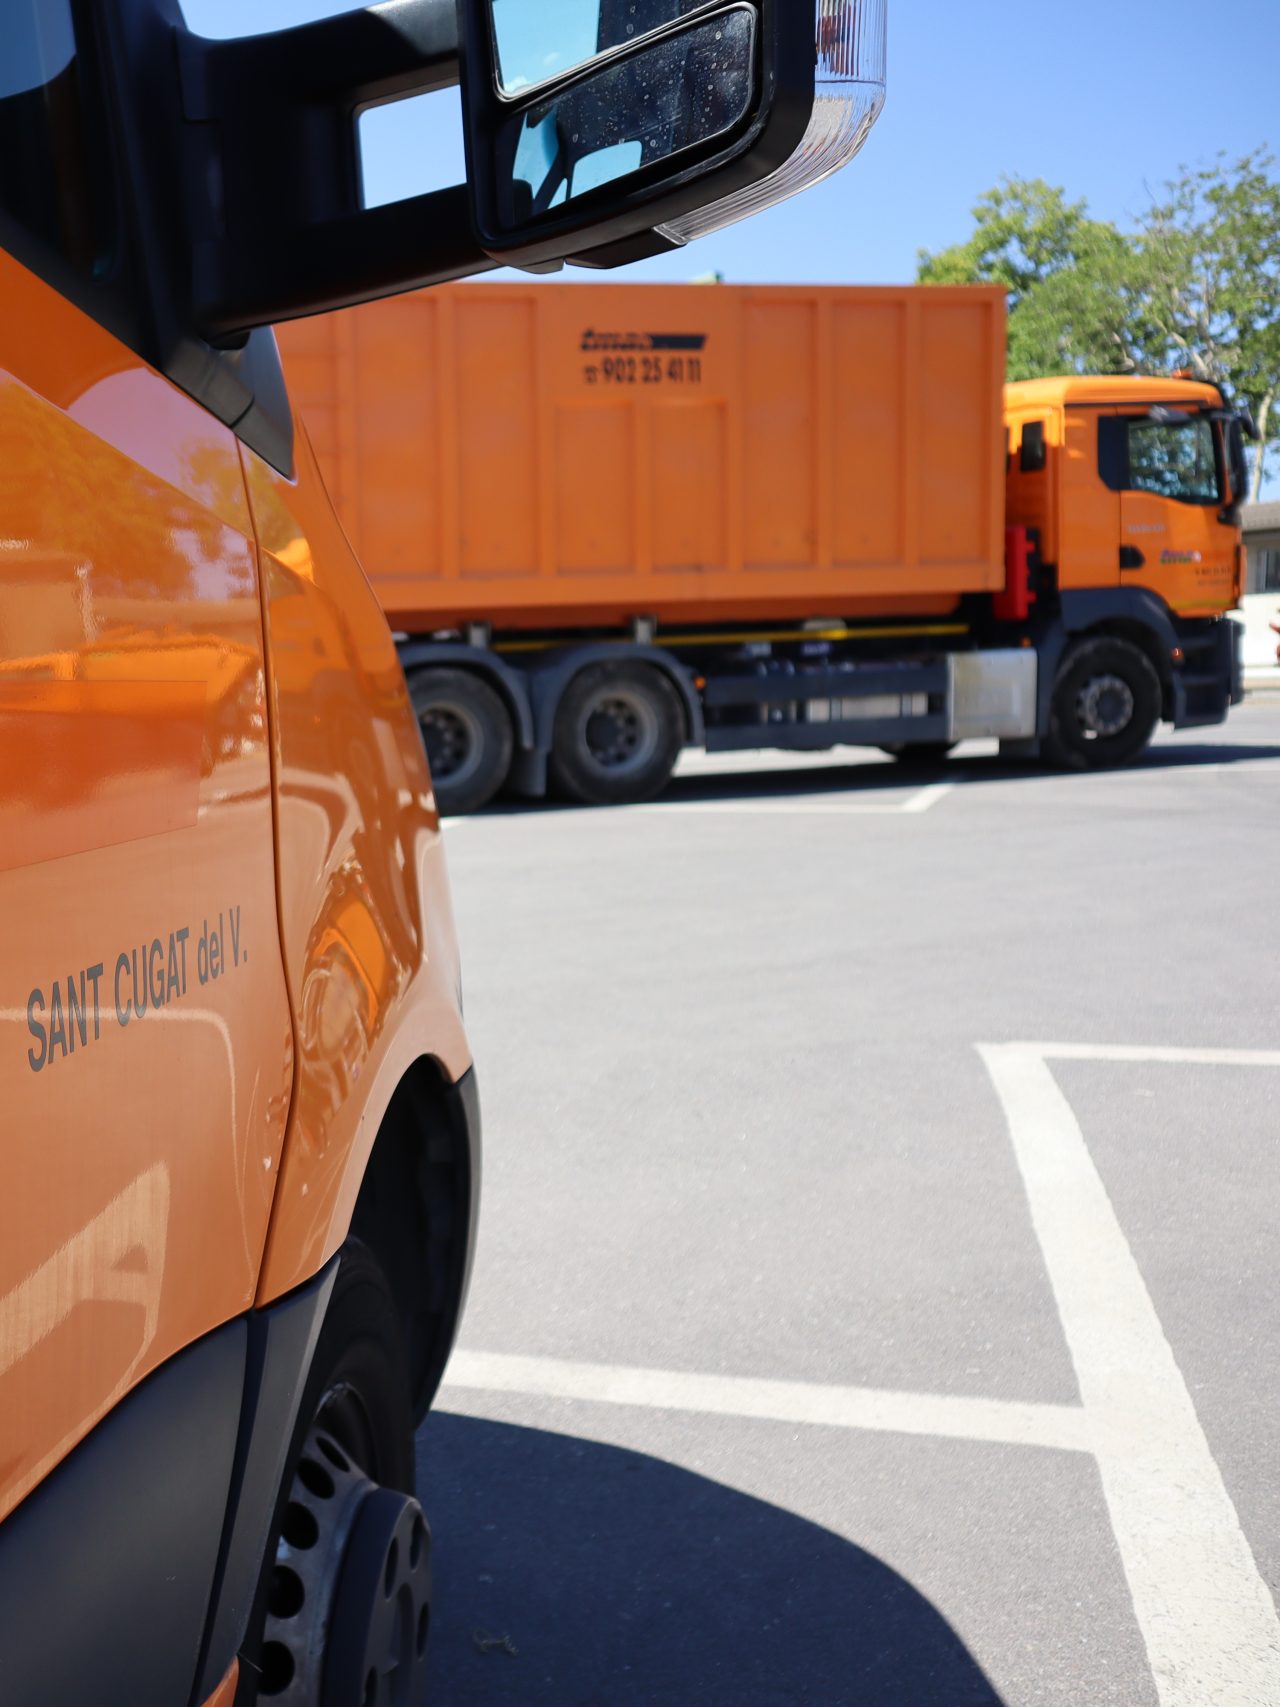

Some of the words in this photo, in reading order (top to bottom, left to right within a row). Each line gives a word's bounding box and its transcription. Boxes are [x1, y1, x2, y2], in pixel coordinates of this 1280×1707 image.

[603, 357, 636, 383] 902
[641, 357, 662, 383] 25
[667, 357, 684, 383] 41
[687, 357, 702, 383] 11
[26, 962, 104, 1073] SANT
[114, 926, 190, 1028] CUGAT
[197, 912, 225, 986] del
[229, 905, 248, 968] V.
